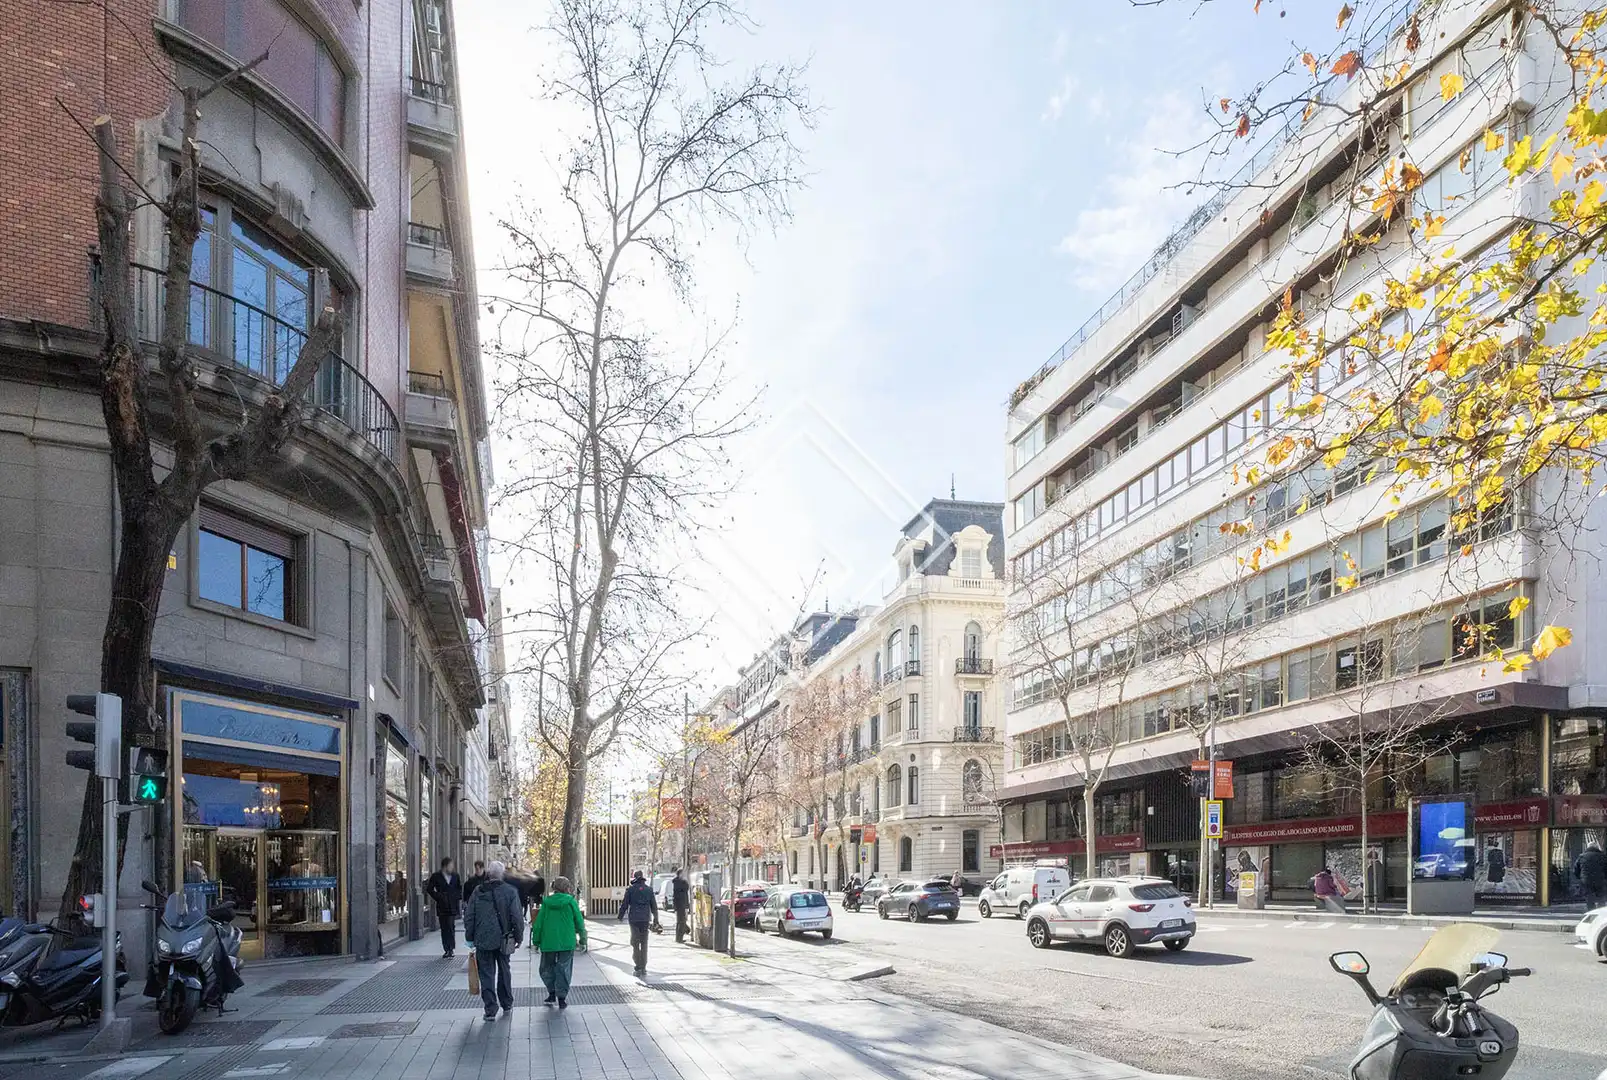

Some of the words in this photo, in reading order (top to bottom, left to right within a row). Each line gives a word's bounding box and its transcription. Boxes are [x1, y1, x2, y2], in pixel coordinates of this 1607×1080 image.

[1253, 830, 1277, 838] COLEGIO
[1286, 826, 1318, 836] ABOGADOS
[1328, 824, 1354, 833] MADRID
